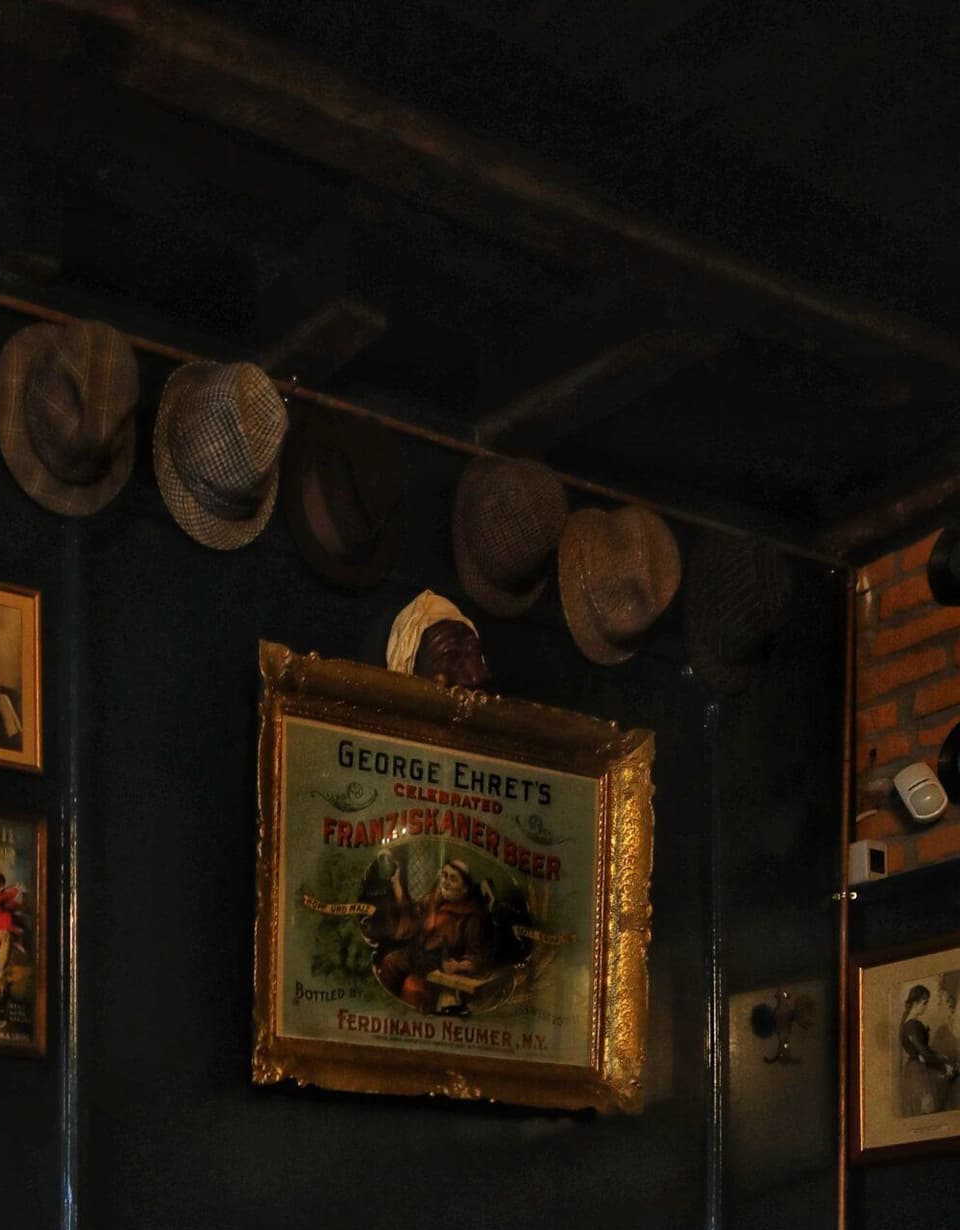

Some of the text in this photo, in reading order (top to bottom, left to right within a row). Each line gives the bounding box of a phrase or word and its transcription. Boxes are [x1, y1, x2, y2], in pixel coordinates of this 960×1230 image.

[338, 740, 551, 805] GEORGE EHRET'S
[393, 782, 503, 815] CELEBRATED
[322, 807, 500, 857] FRANZISKANER
[503, 836, 561, 881] BEER
[295, 980, 345, 1004] BOTTLED
[336, 1009, 436, 1039] FERDINAND
